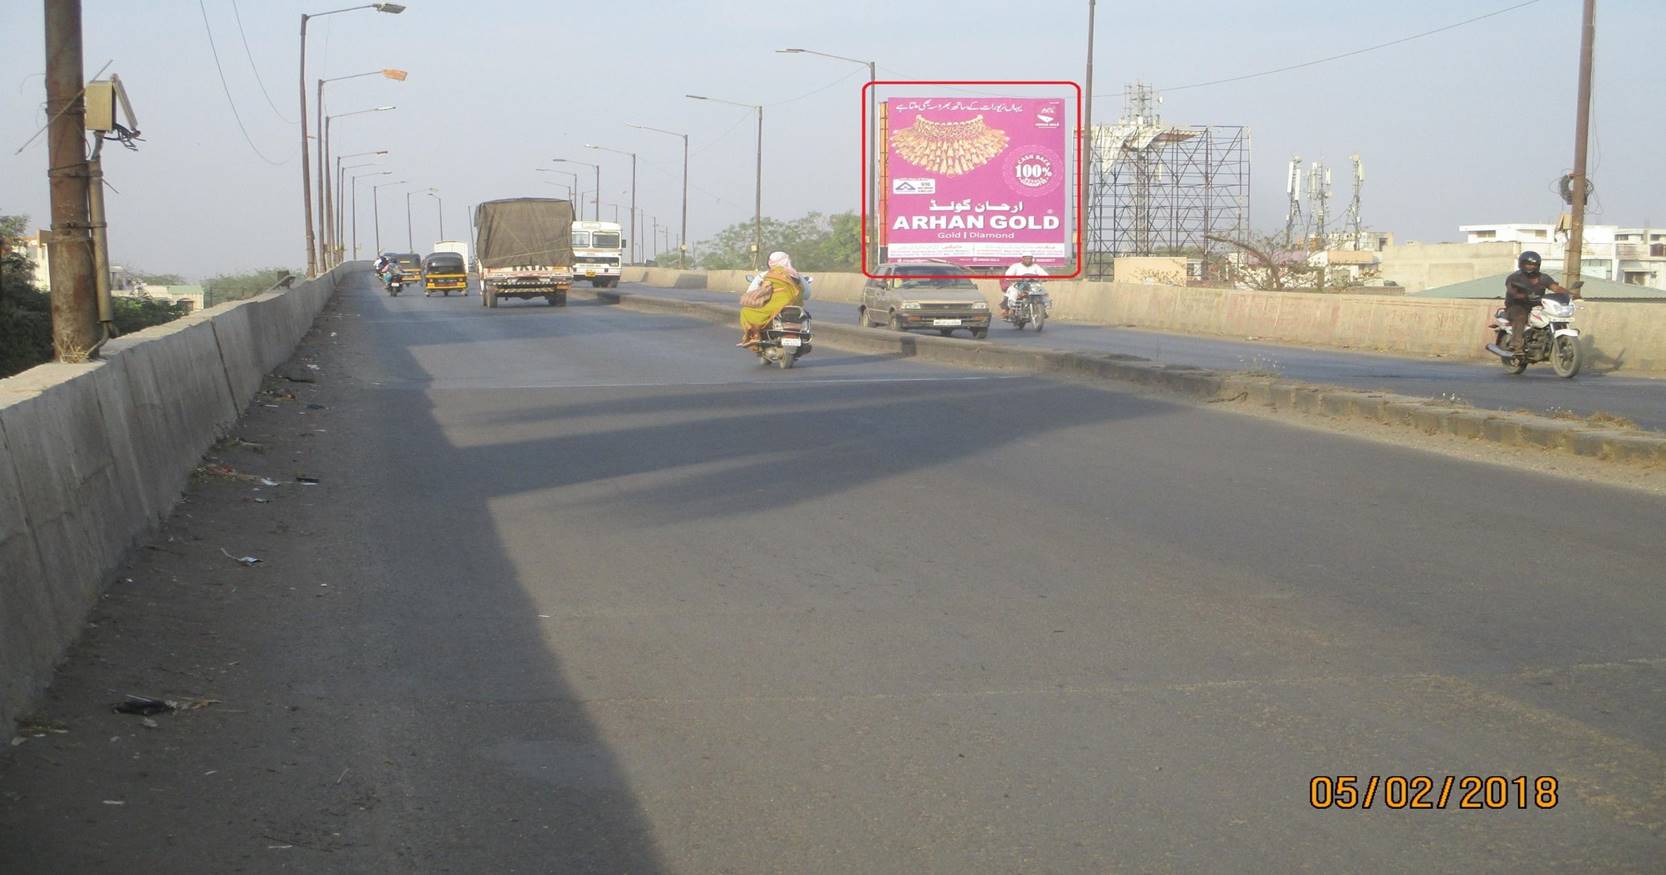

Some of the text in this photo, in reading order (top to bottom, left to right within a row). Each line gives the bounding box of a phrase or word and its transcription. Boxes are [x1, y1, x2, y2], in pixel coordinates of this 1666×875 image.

[1015, 163, 1053, 178] 100%
[928, 199, 1024, 213] ارحان گولڈ
[892, 215, 1060, 230] ARHAN GOLD
[937, 231, 961, 239] Gold
[969, 231, 1015, 239] Diamond
